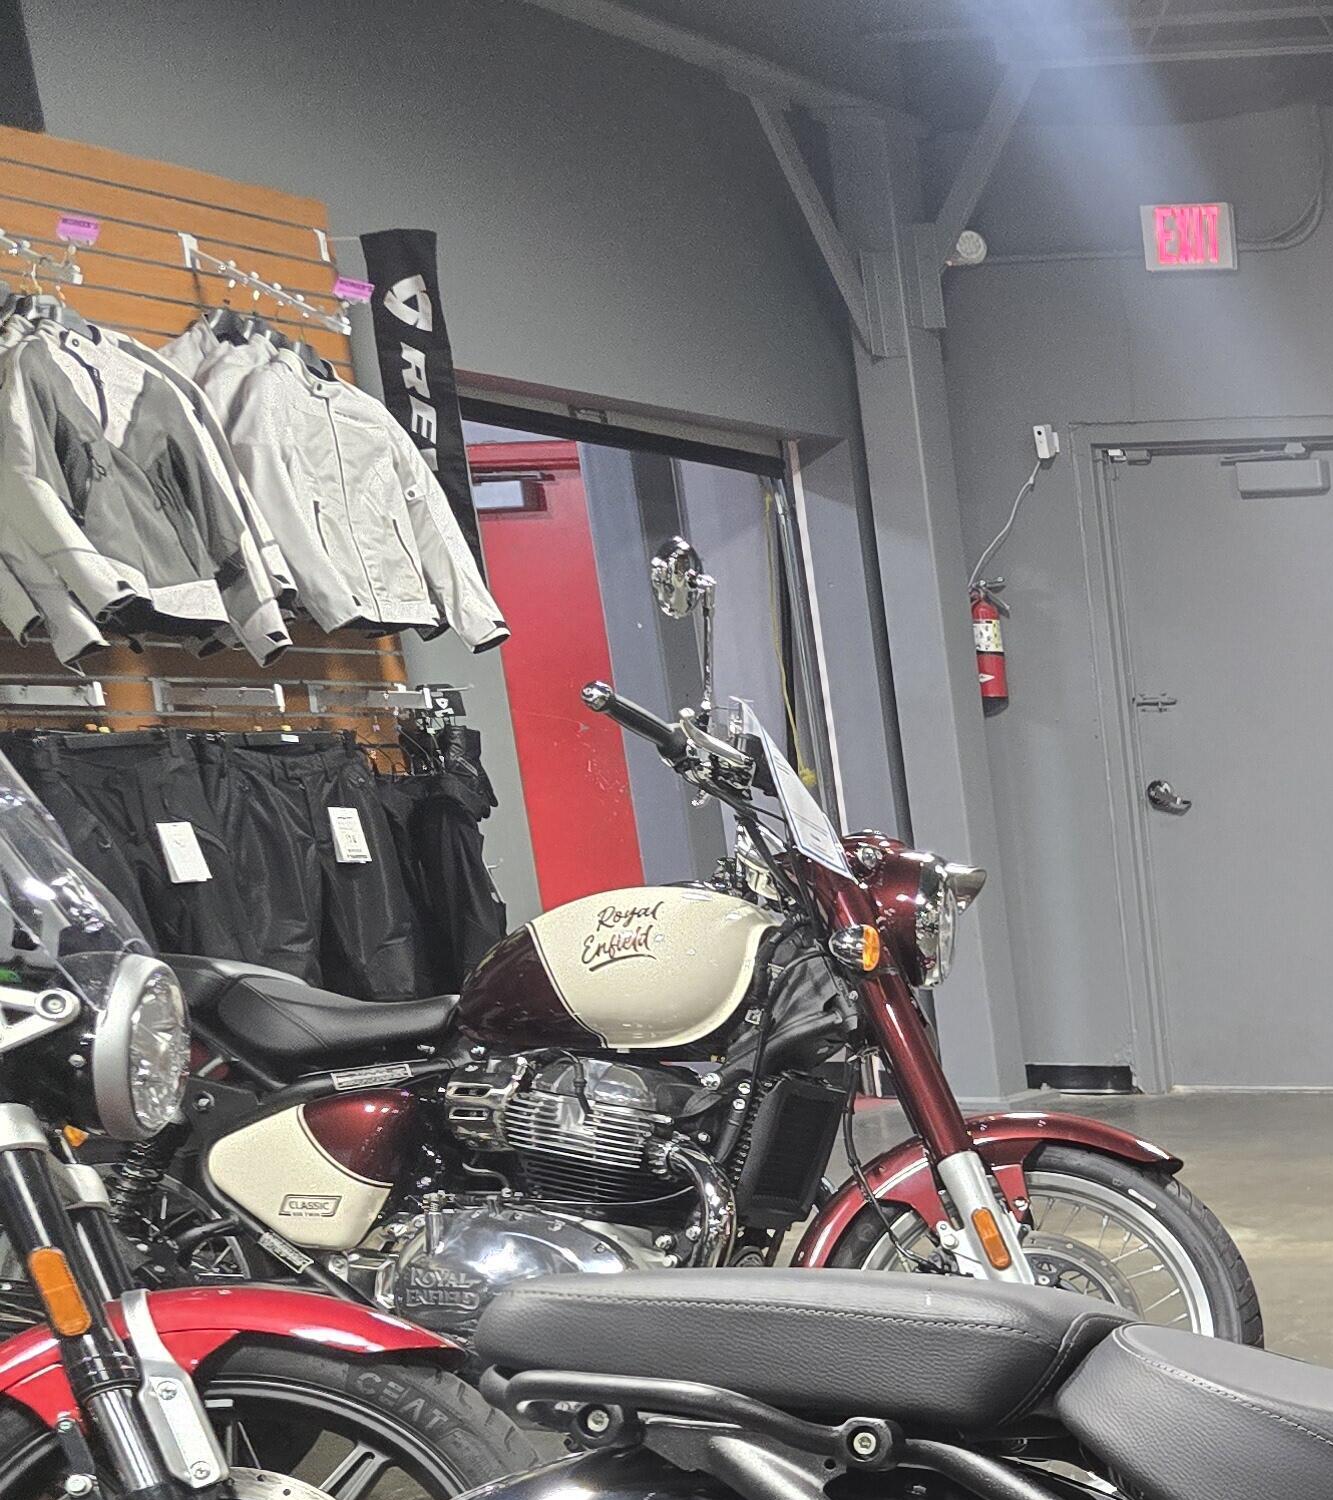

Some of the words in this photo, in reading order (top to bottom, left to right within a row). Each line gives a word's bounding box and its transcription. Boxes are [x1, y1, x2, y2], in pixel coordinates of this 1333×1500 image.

[1154, 206, 1218, 264] EXIT
[597, 901, 664, 932] Royal
[581, 925, 653, 964] Enfield
[289, 1200, 329, 1210] CLASSIC
[410, 1266, 481, 1288] ROYAL
[406, 1288, 480, 1310] ENFIELD
[356, 1372, 449, 1430] CEAT
